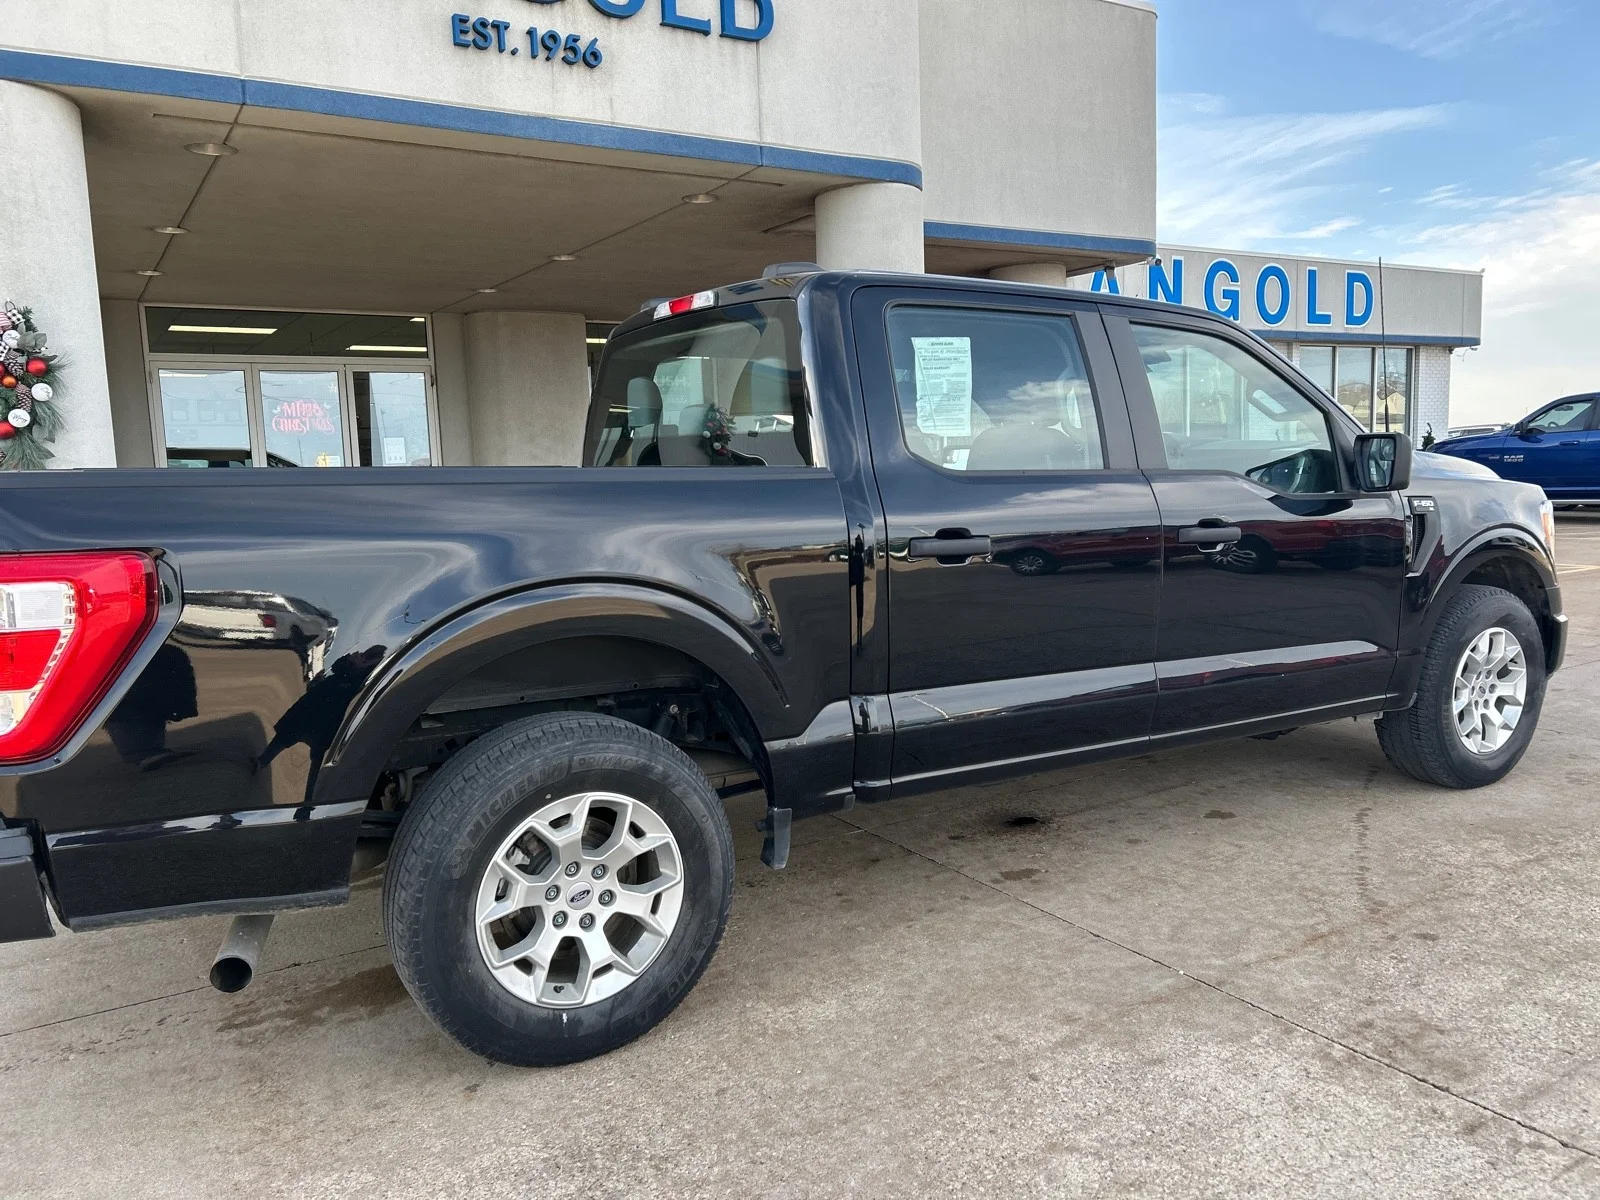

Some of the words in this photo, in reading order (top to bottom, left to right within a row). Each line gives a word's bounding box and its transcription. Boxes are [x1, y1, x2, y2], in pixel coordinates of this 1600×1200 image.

[451, 13, 519, 56] EST.
[526, 27, 603, 69] 1956
[524, 0, 774, 41] LD
[272, 414, 336, 436] CHRISTMAS
[466, 760, 563, 844] MICHELIN
[578, 755, 644, 771] PRIMACY
